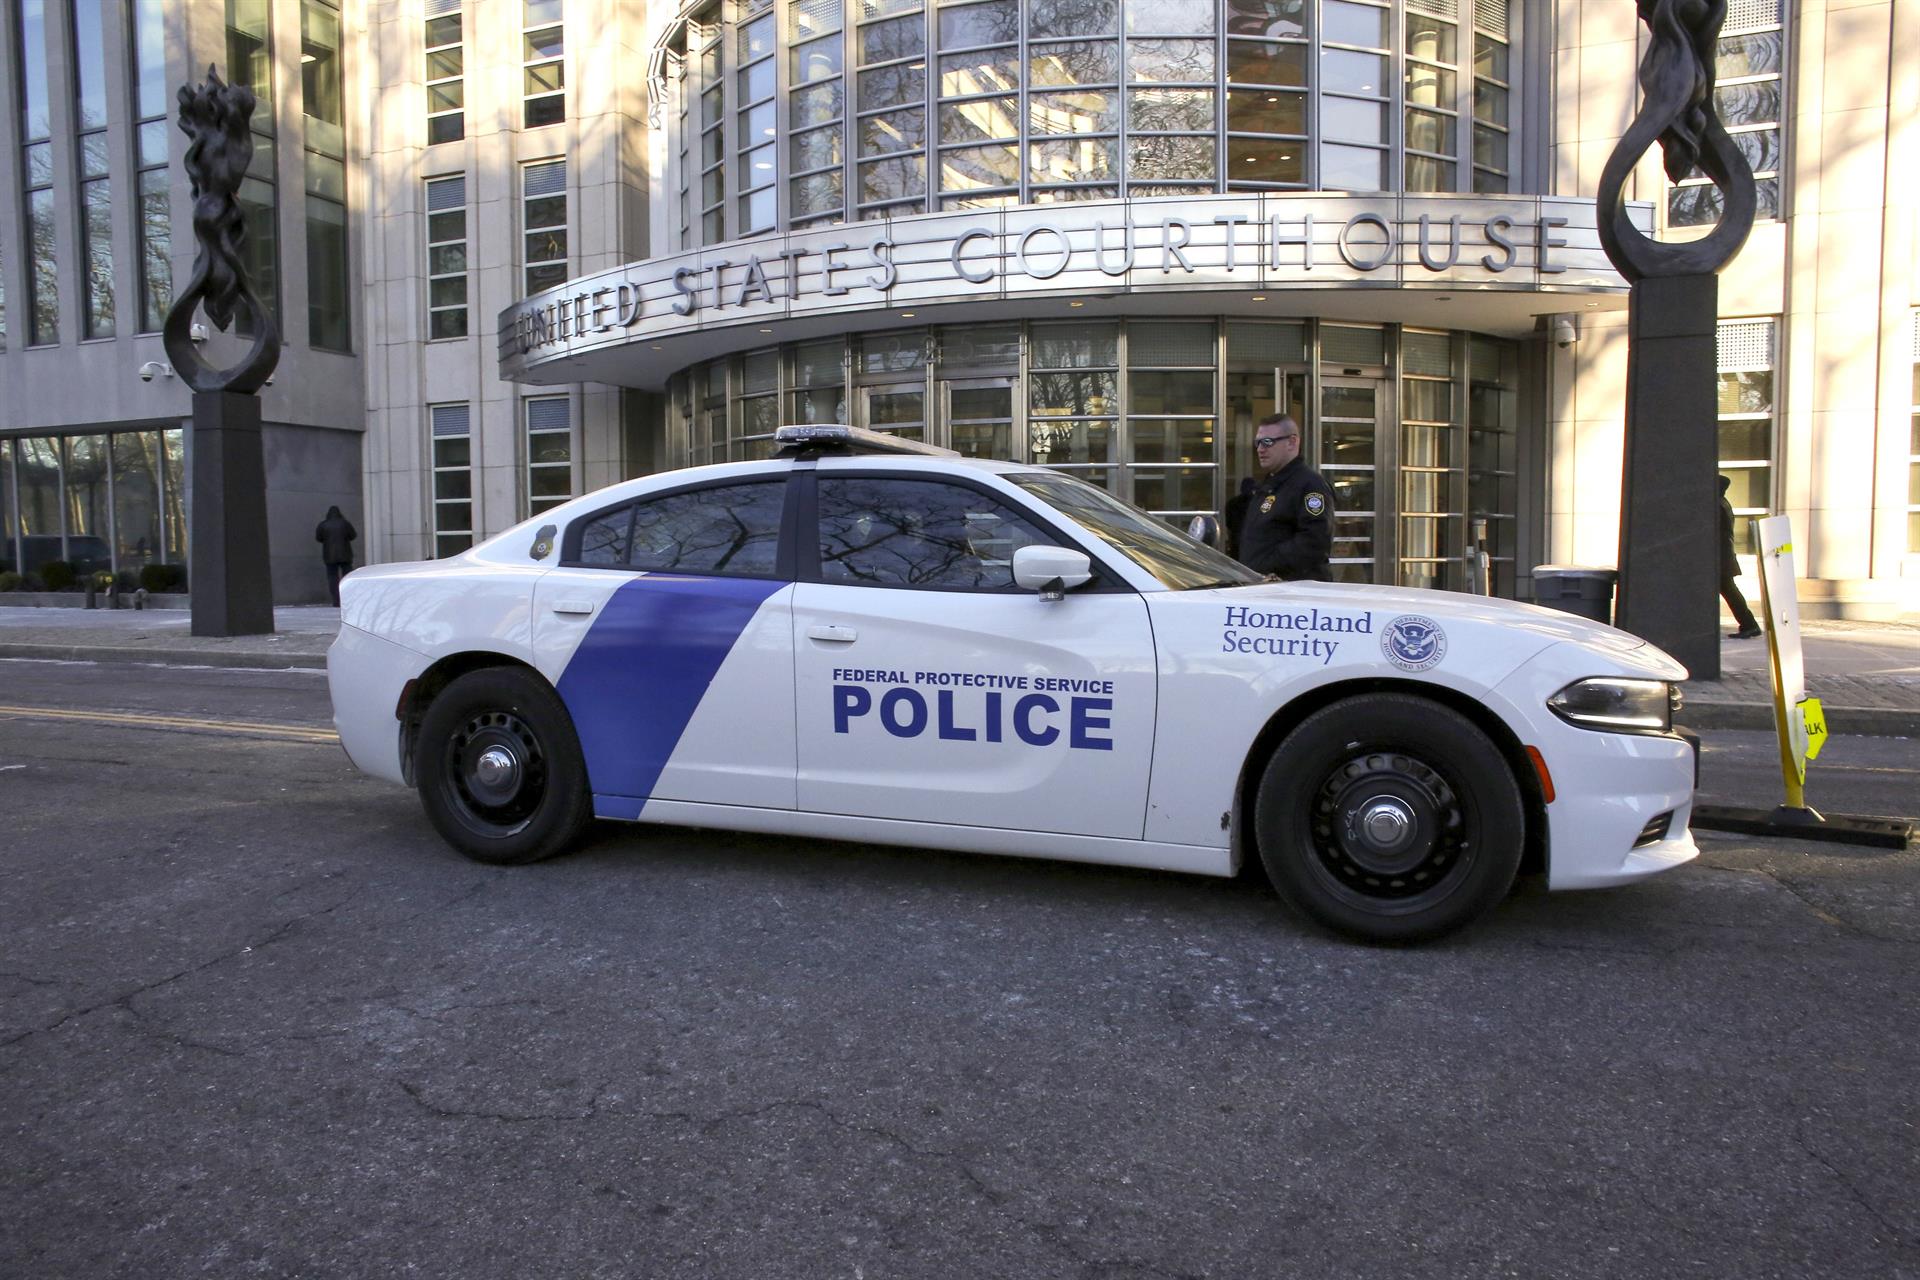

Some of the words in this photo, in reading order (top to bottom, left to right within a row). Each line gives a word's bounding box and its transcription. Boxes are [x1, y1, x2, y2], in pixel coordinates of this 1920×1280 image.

[516, 279, 638, 354] UNITED
[671, 237, 897, 316] STATES
[950, 212, 1568, 283] COURTHOUSE
[1223, 606, 1373, 634] Homeland
[1223, 630, 1339, 665] Security
[1383, 643, 1413, 670] HOMELAND
[1416, 647, 1443, 670] SECURITY
[833, 668, 909, 683] FEDERAL
[915, 672, 1028, 689] PROTECTIVE
[1034, 677, 1113, 694] SERVICE
[833, 685, 1113, 750] POLICE
